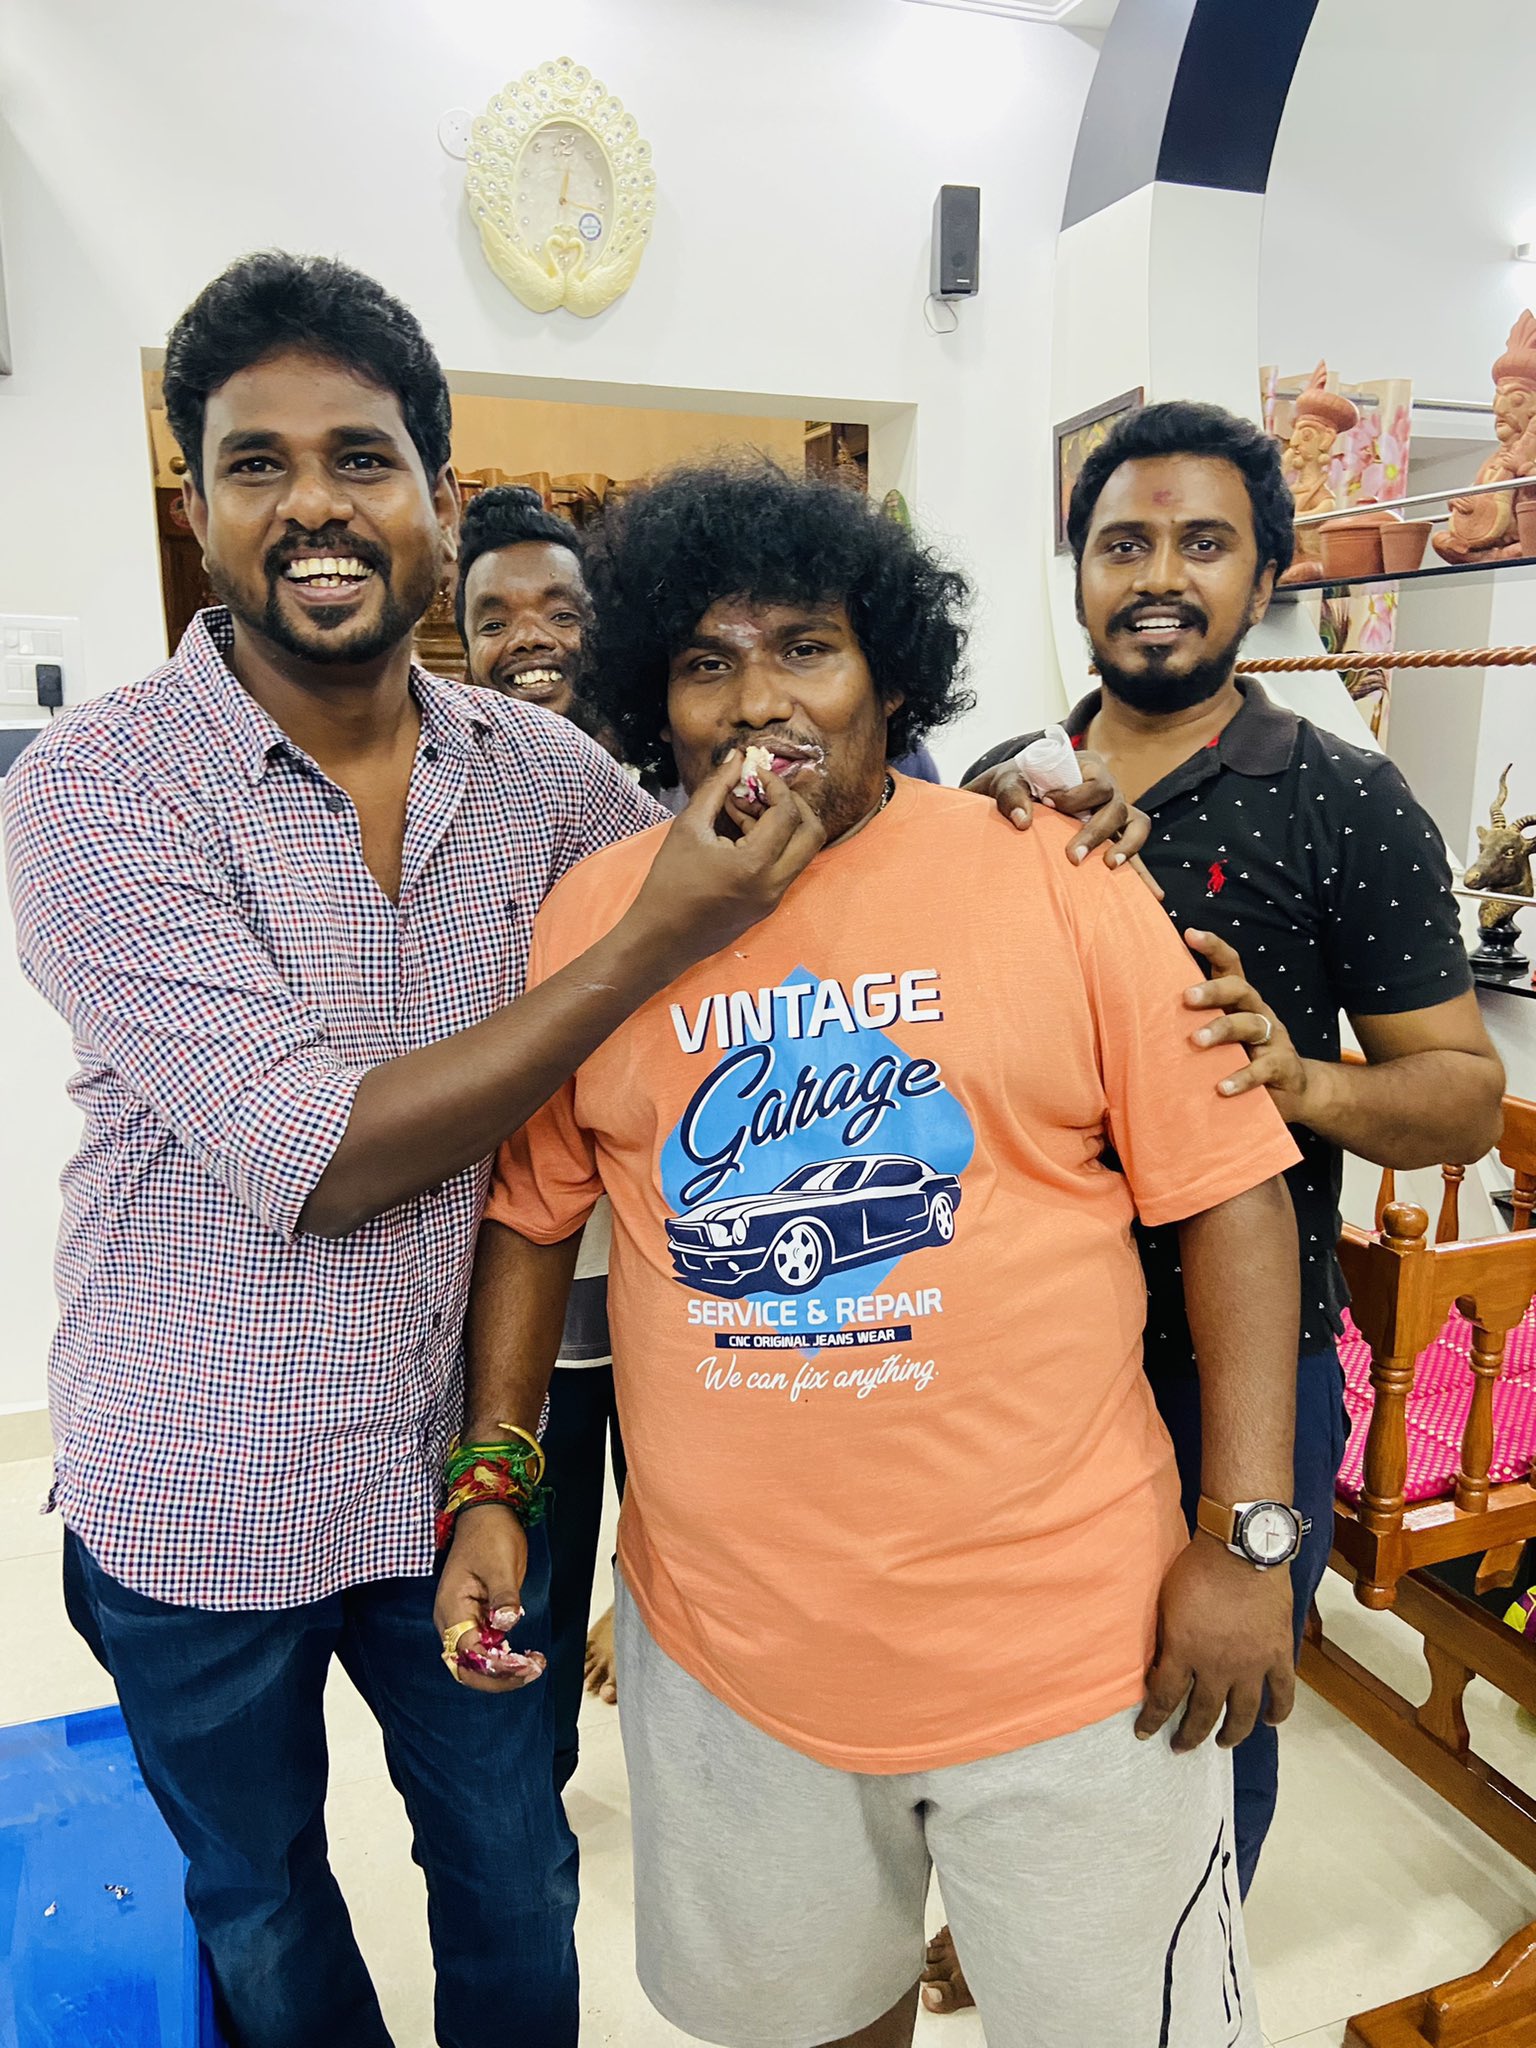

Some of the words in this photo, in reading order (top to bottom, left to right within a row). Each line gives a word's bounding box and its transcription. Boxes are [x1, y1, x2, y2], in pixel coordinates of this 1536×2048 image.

[551, 133, 576, 158] 12
[669, 968, 944, 1054] VINTAGE
[680, 1044, 946, 1205] Garage
[687, 1298, 798, 1327] SERVICE
[806, 1298, 829, 1326] &
[836, 1287, 943, 1324] REPAIR
[728, 1335, 751, 1348] CNC
[753, 1334, 810, 1348] ORIGINAL
[812, 1332, 854, 1347] JEANS
[856, 1328, 896, 1343] WEAR
[696, 1353, 743, 1391] We
[746, 1371, 789, 1390] can
[789, 1361, 830, 1403] fix
[833, 1353, 940, 1399] anything.
